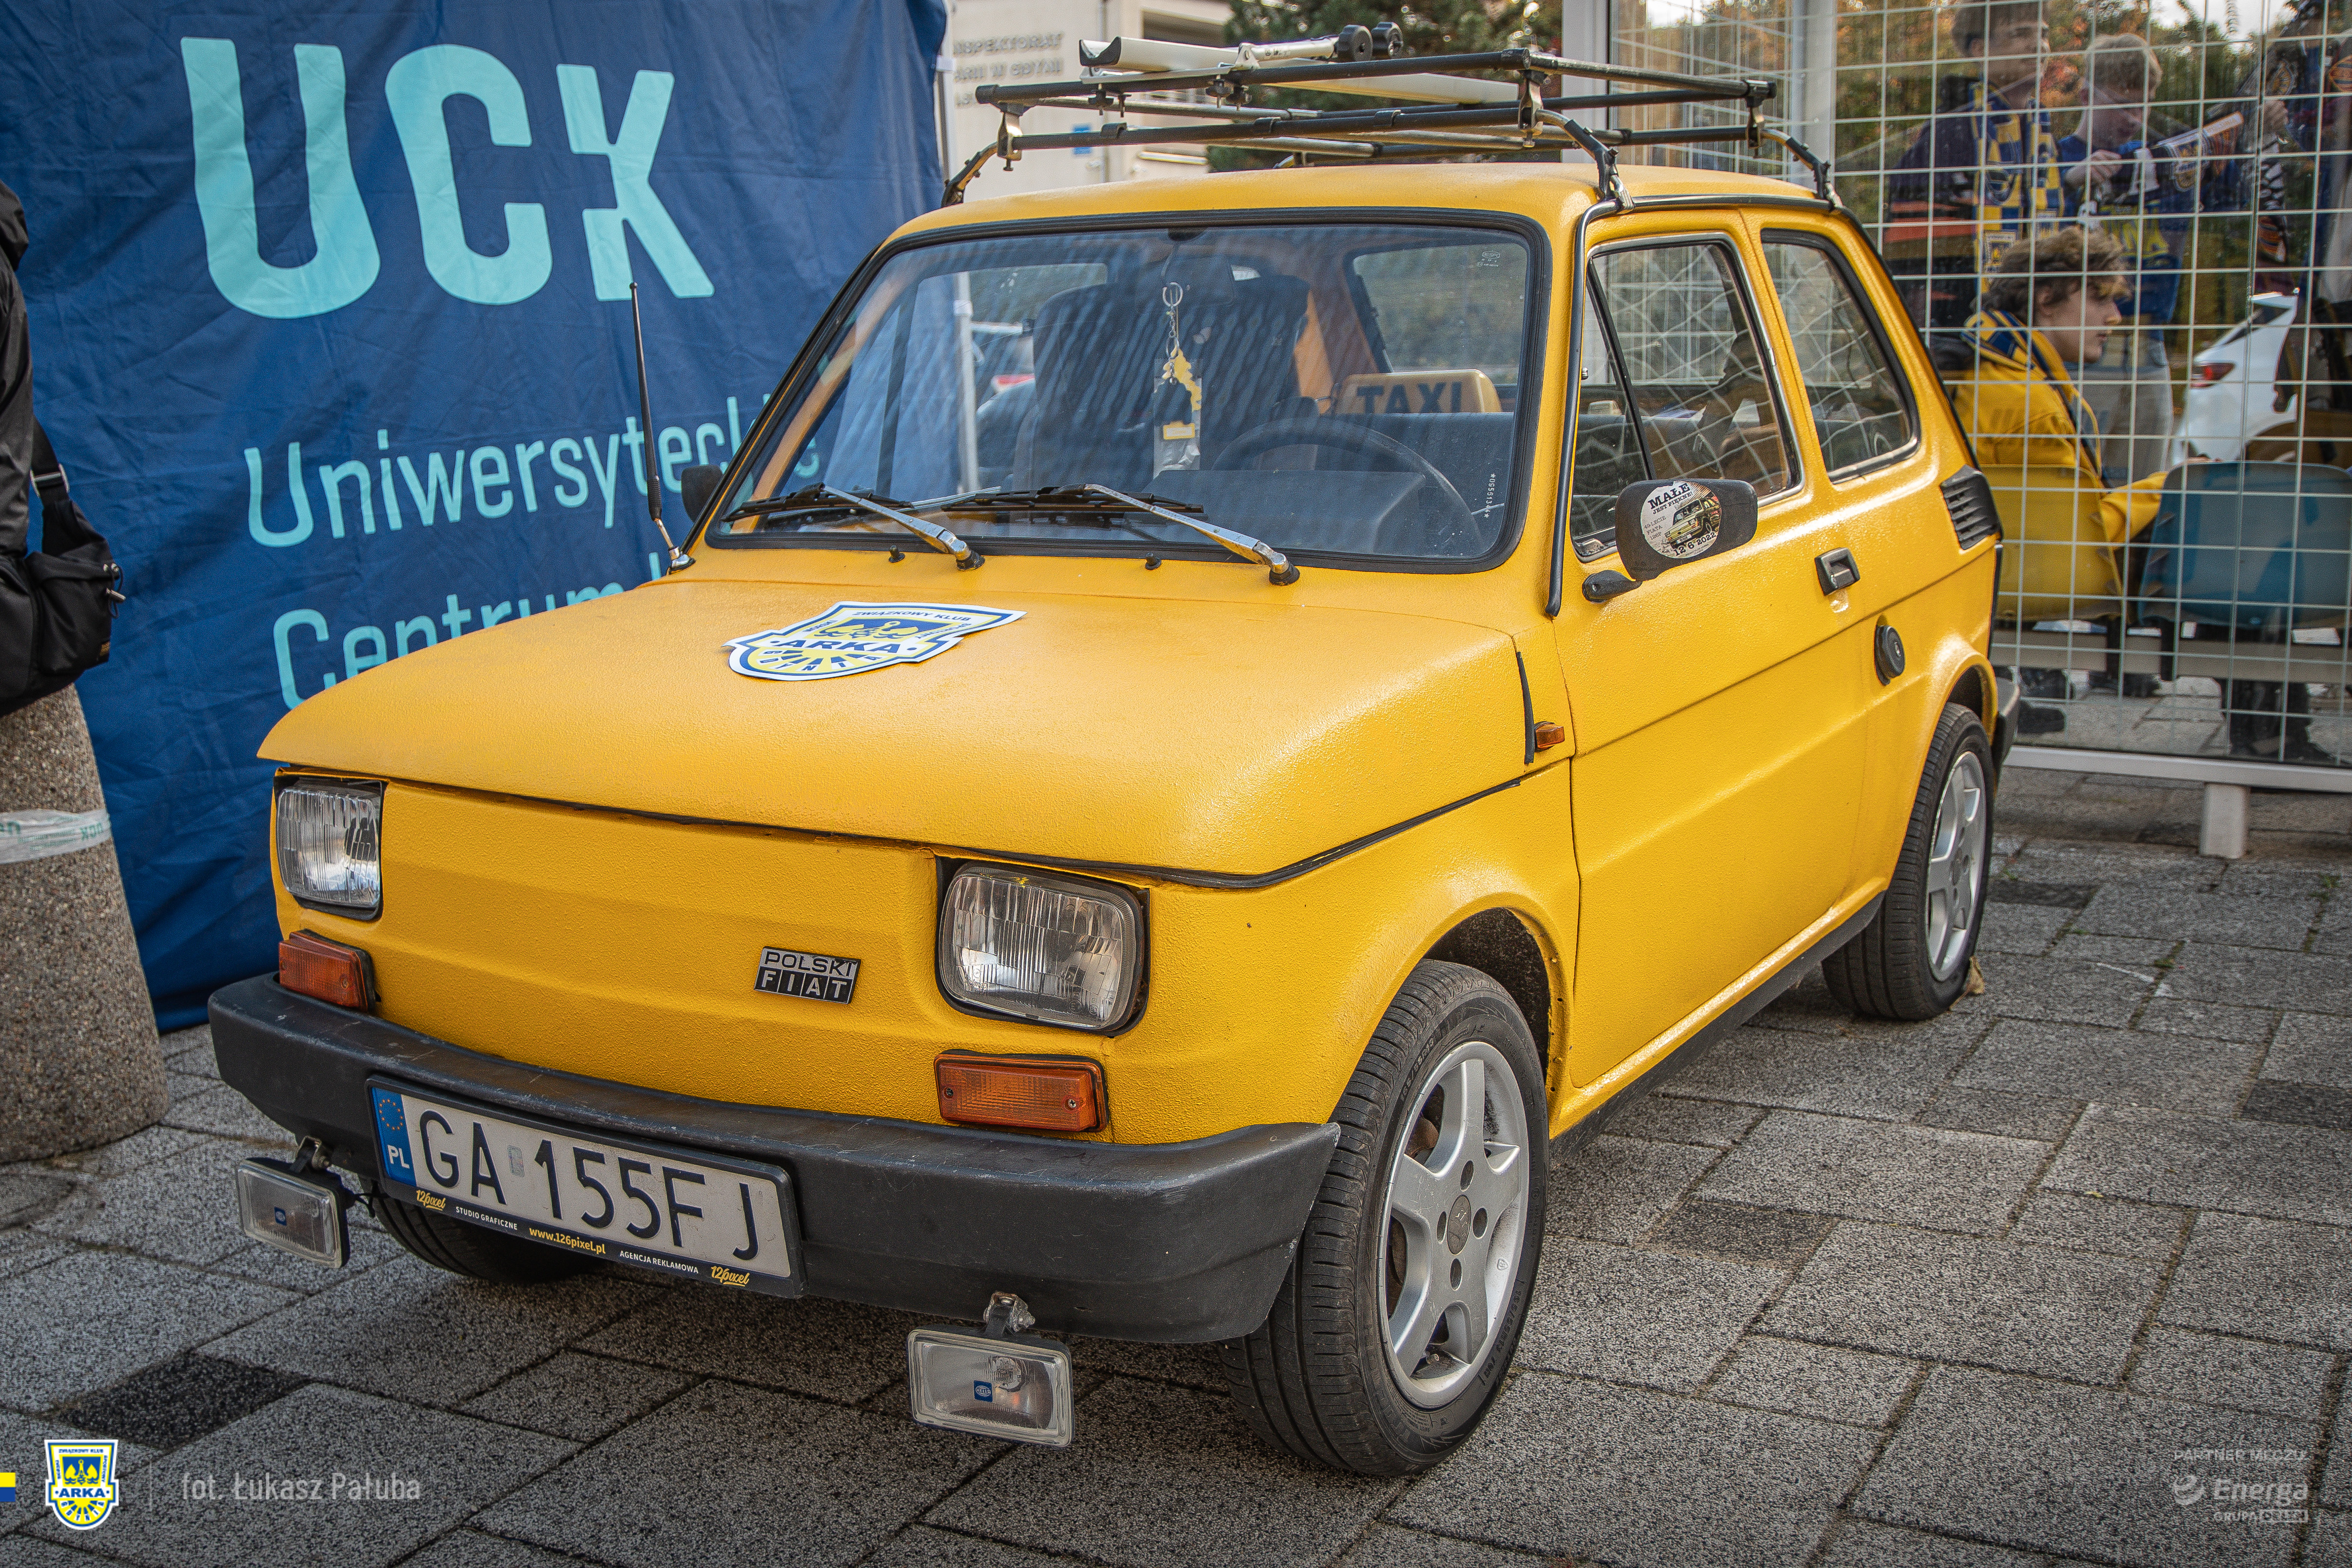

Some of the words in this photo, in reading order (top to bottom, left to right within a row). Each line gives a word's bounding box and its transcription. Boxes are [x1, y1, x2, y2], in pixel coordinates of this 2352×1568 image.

[180, 36, 715, 318] UCK
[1356, 382, 1462, 413] TAXI
[1647, 483, 1690, 509] MAŁE
[1653, 503, 1667, 515] JEST
[1673, 546, 1686, 556] 12
[1696, 532, 1716, 546] 2022
[773, 639, 902, 654] ARKA
[764, 951, 852, 977] POLSKI
[762, 970, 847, 999] FIAT
[387, 1144, 410, 1170] PL
[419, 1110, 508, 1206] GA
[455, 1206, 479, 1220] STUDIO
[480, 1213, 518, 1231] GRAFICZNE
[529, 1227, 606, 1254] www.126pixel.pl
[620, 1251, 652, 1265] AGENCJA
[652, 1257, 699, 1274] REKLAMOWA
